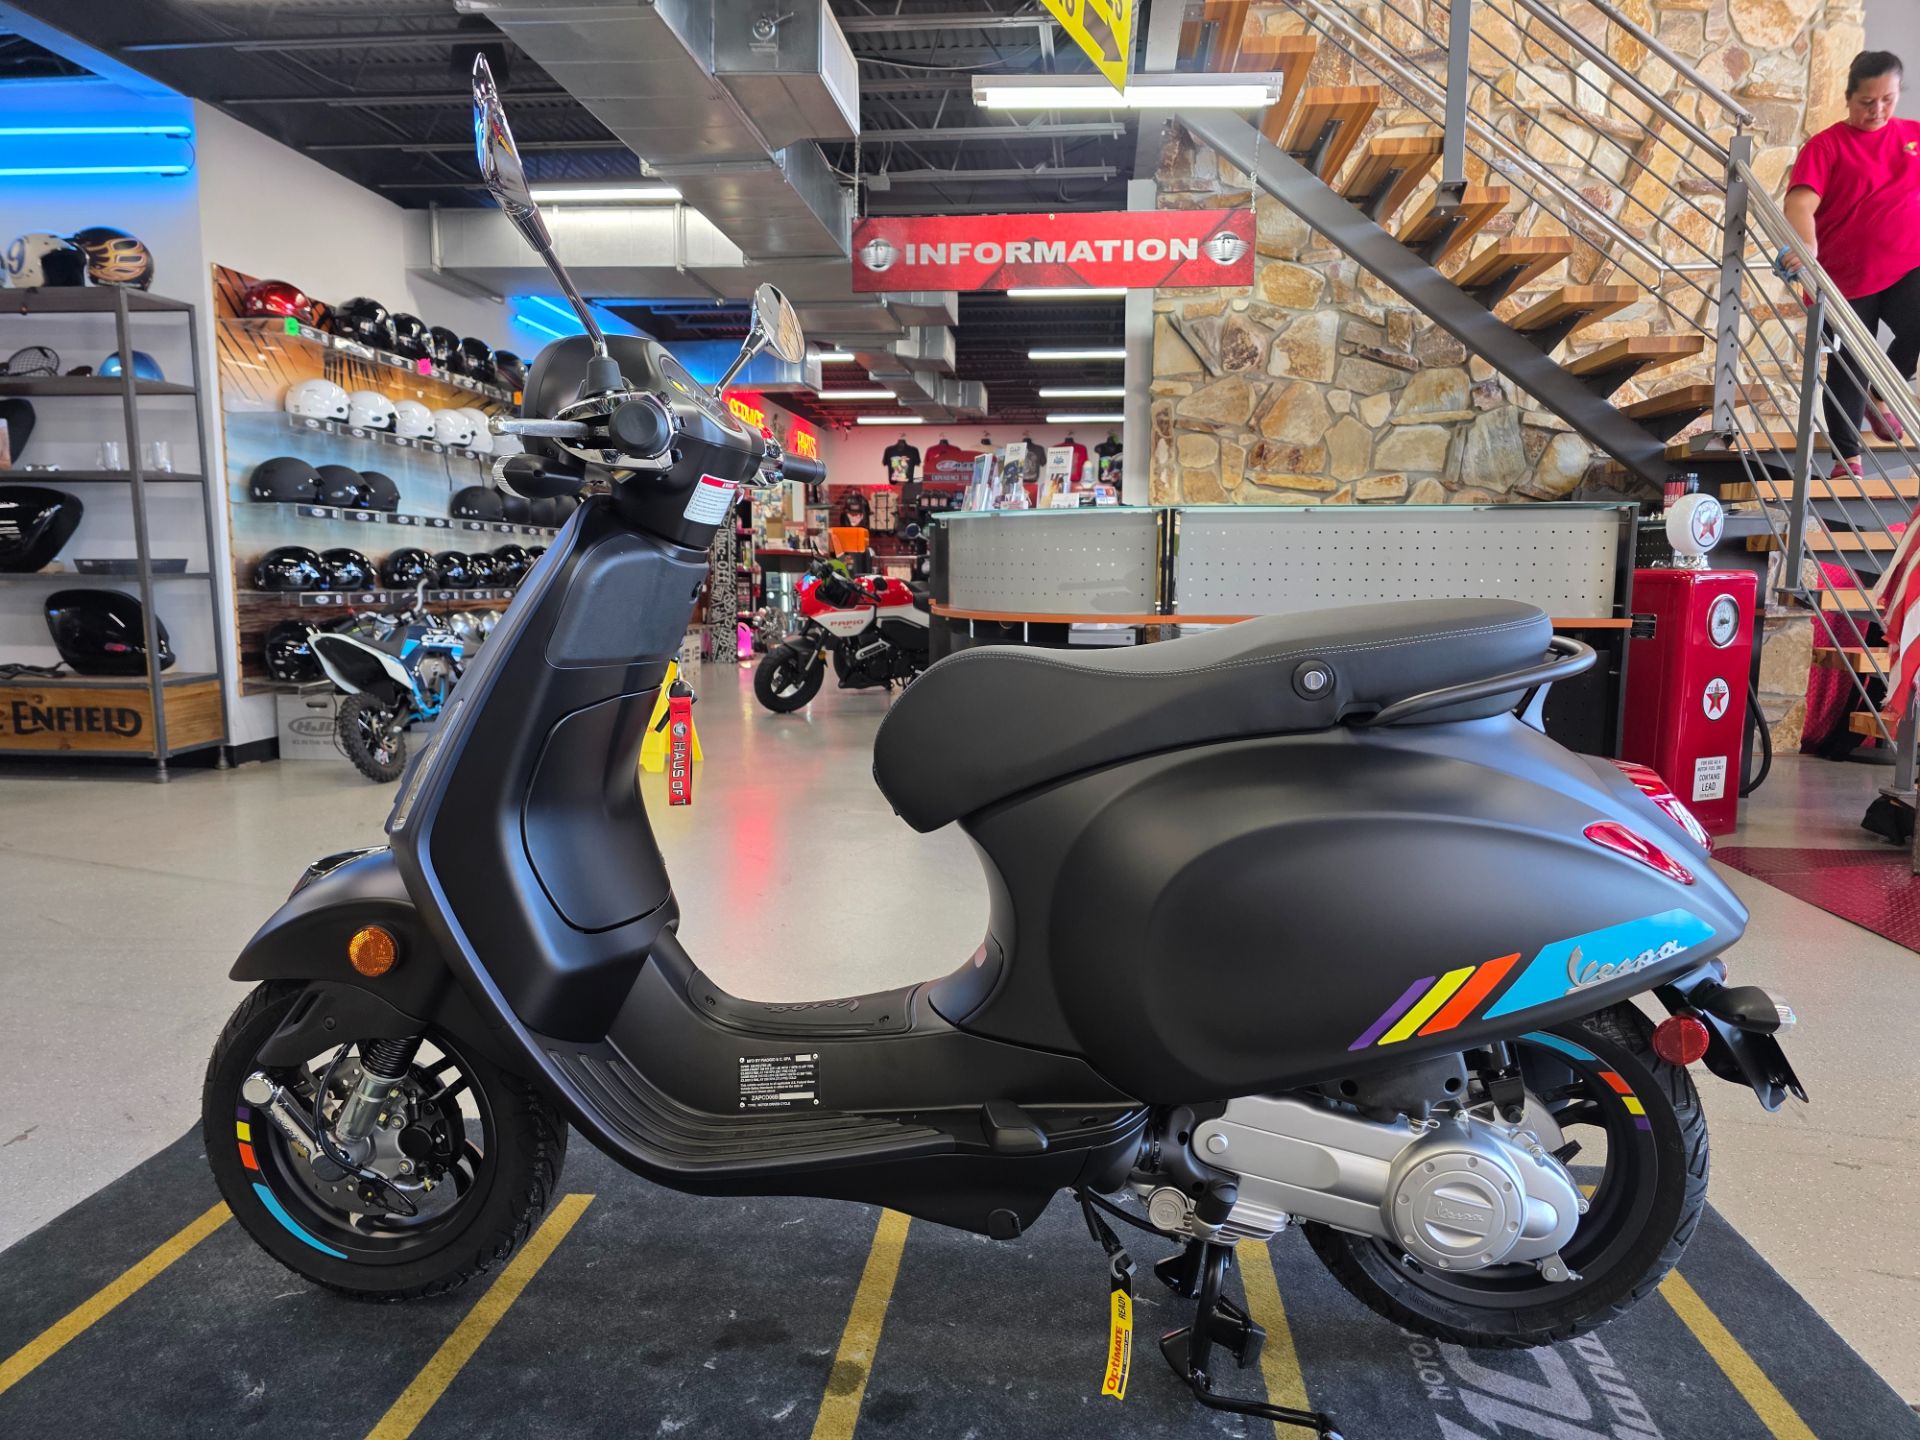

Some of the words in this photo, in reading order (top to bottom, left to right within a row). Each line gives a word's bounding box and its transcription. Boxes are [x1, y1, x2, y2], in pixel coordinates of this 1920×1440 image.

[906, 238, 1198, 265] INFORMATION
[715, 529, 730, 585] Muc-Off
[11, 700, 143, 737] ENFIELD
[673, 742, 686, 778] HAUS
[672, 781, 684, 796] OF
[1698, 773, 1721, 782] CONTAINS
[1701, 782, 1717, 792] LEAD
[1564, 939, 1688, 996] Vespa
[1437, 1200, 1485, 1222] Vespa
[1118, 1295, 1126, 1320] READY
